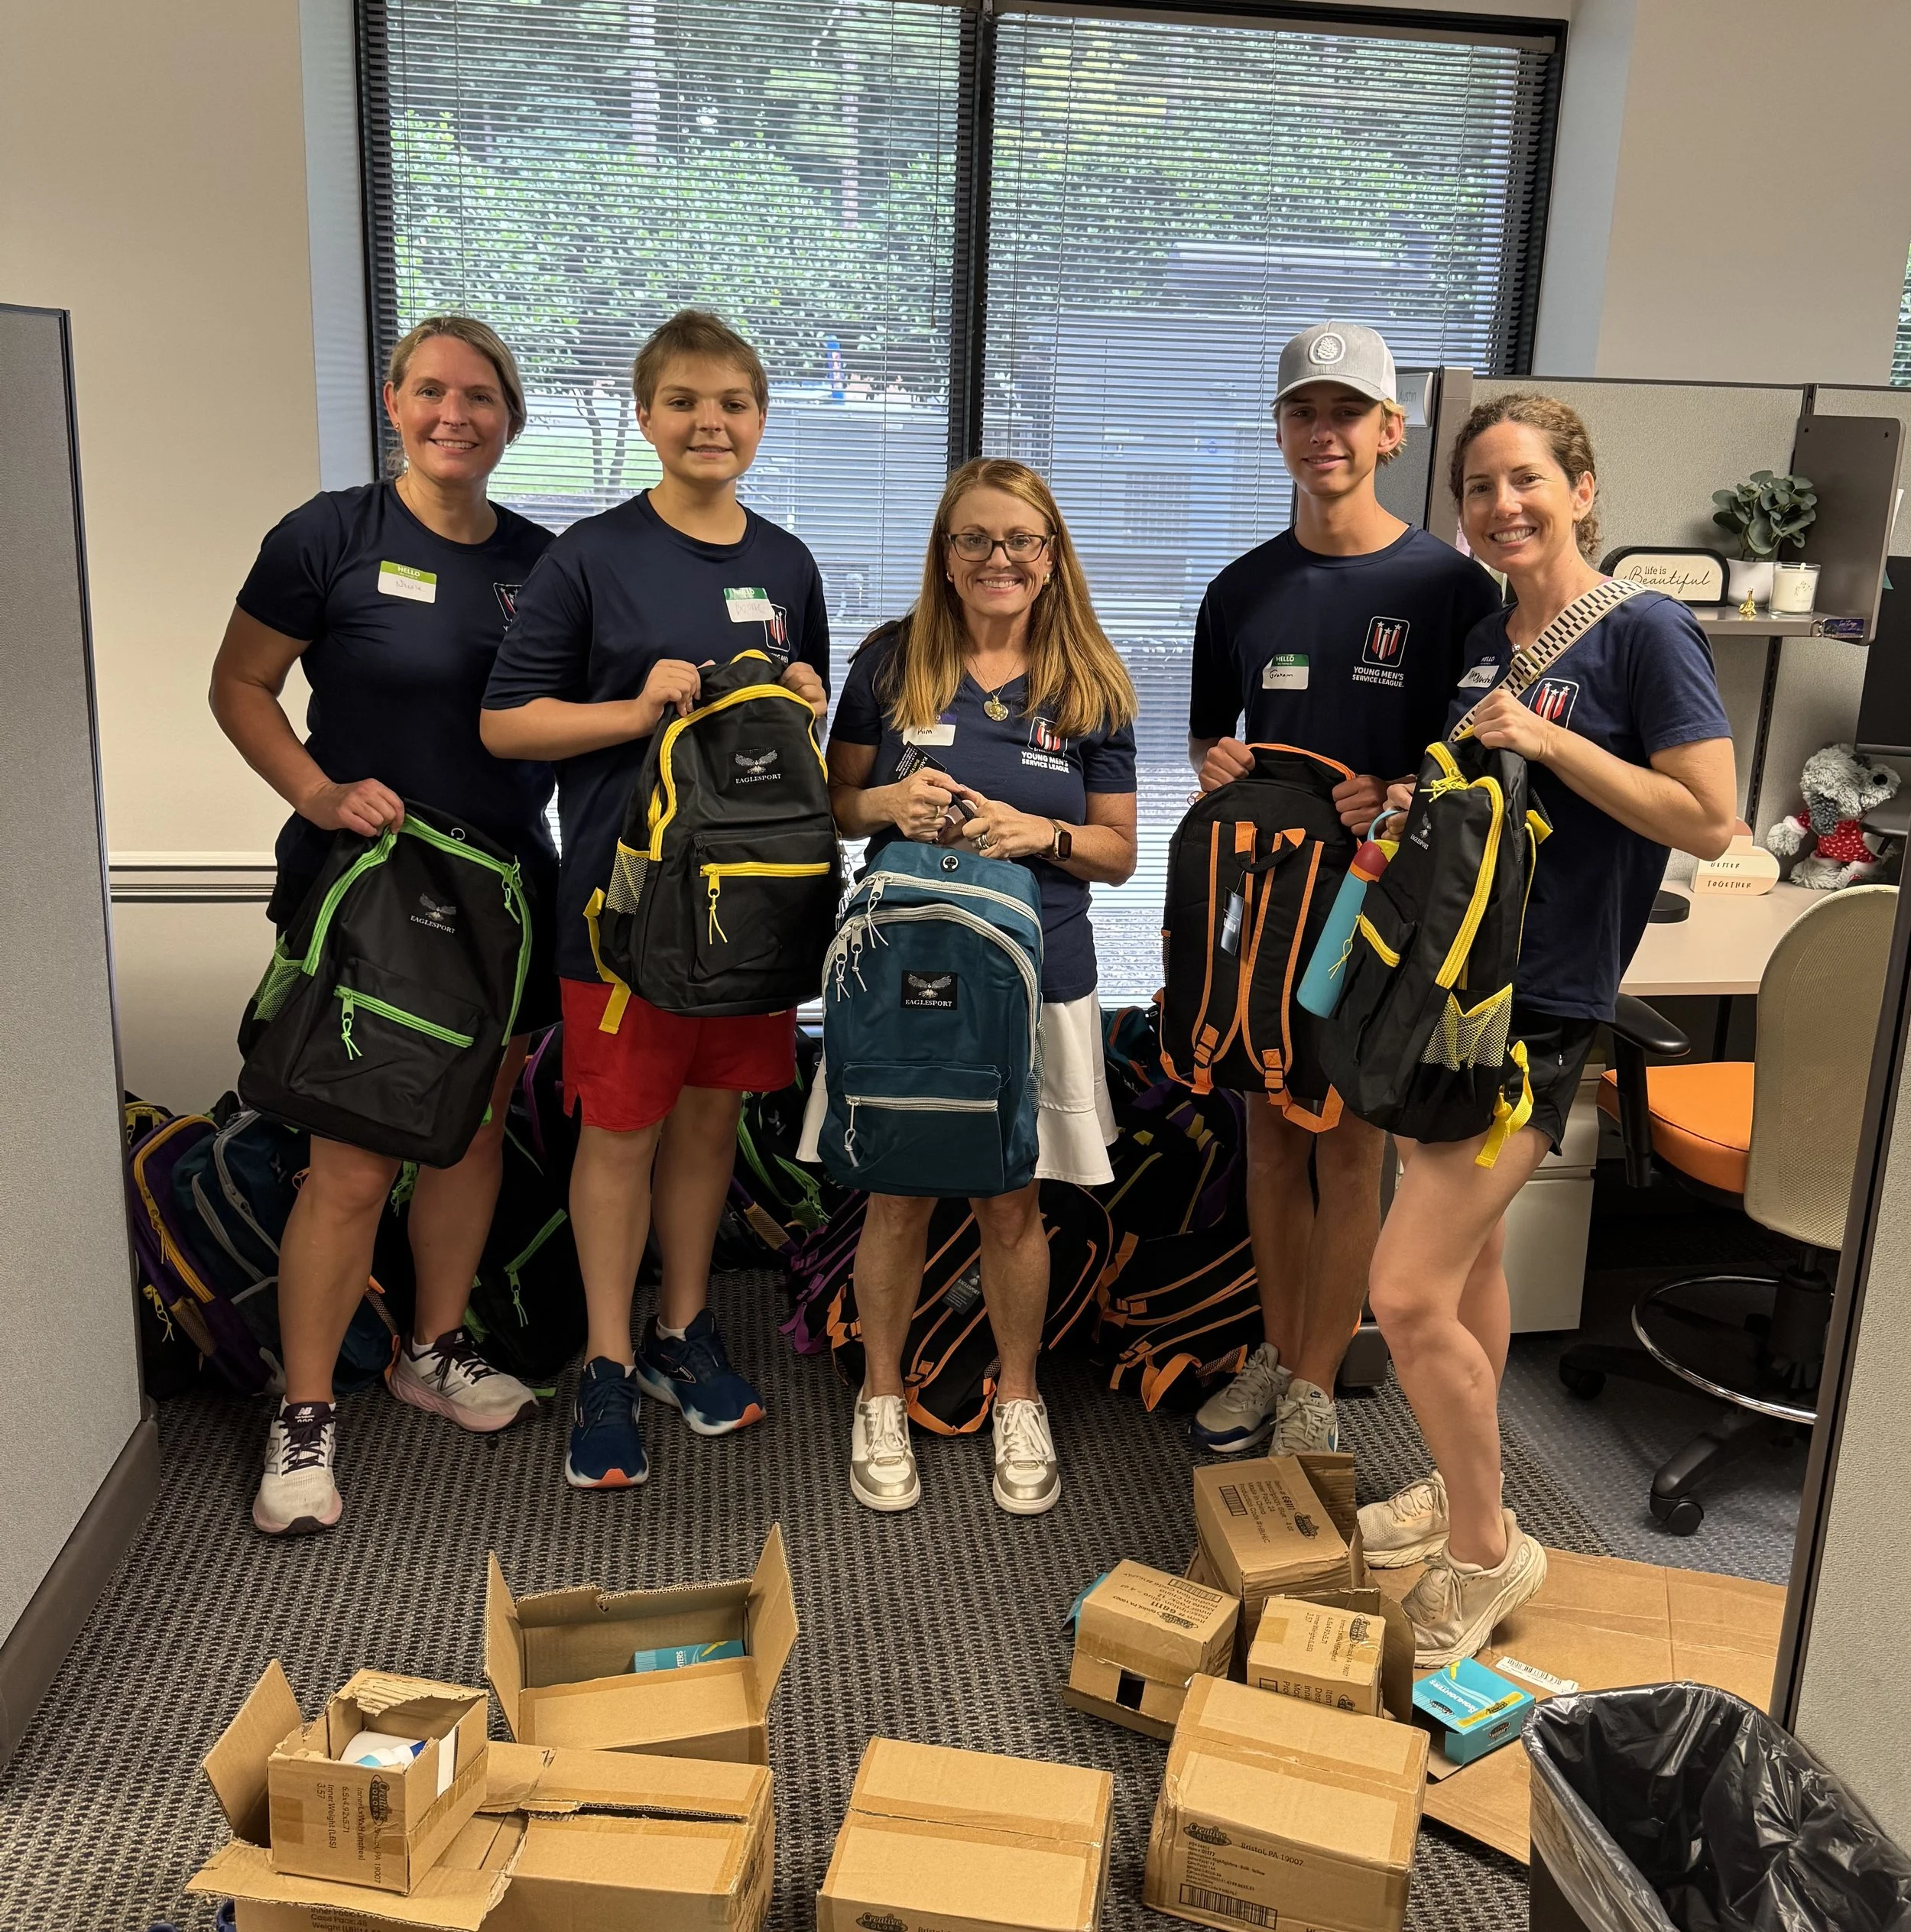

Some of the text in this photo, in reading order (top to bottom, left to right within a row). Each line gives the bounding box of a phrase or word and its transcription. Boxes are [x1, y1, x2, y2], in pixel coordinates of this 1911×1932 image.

[397, 566, 420, 577] HELLO
[1645, 566, 1666, 575] life is
[1627, 566, 1711, 595] Beautiful
[1352, 674, 1378, 683] SERVICE
[1354, 666, 1404, 681] YOUNG MEN'S
[1021, 751, 1069, 767] YOUNG MEN'S
[1021, 758, 1048, 768] SERVICE
[735, 773, 782, 784] EAGLESPORT
[410, 915, 456, 934] EAGLESPORT
[905, 999, 952, 1007] EAGLESPORT
[1238, 1483, 1253, 1506] Production
[1250, 1507, 1260, 1520] Code
[1248, 1482, 1257, 1494] Made
[1256, 1500, 1266, 1514] China
[1153, 1581, 1174, 1591] Code
[1159, 1588, 1182, 1600] China
[1150, 1600, 1176, 1613] 68111
[1162, 1599, 1208, 1619] Description:
[1192, 1602, 1215, 1611] Made
[1351, 1619, 1359, 1638] COLORS
[1429, 1679, 1478, 1713] HIGHLIGHTERS
[316, 1783, 326, 1799] 3.57
[378, 1782, 390, 1821] Creative
[326, 1803, 335, 1828] Weight
[1189, 1823, 1225, 1839] Creative
[329, 1829, 337, 1849] (LBS)
[375, 1852, 381, 1860] PA
[1240, 1843, 1303, 1866] Bristol, PA 19007
[313, 1921, 340, 1931] Weight
[863, 1912, 900, 1926] Creative
